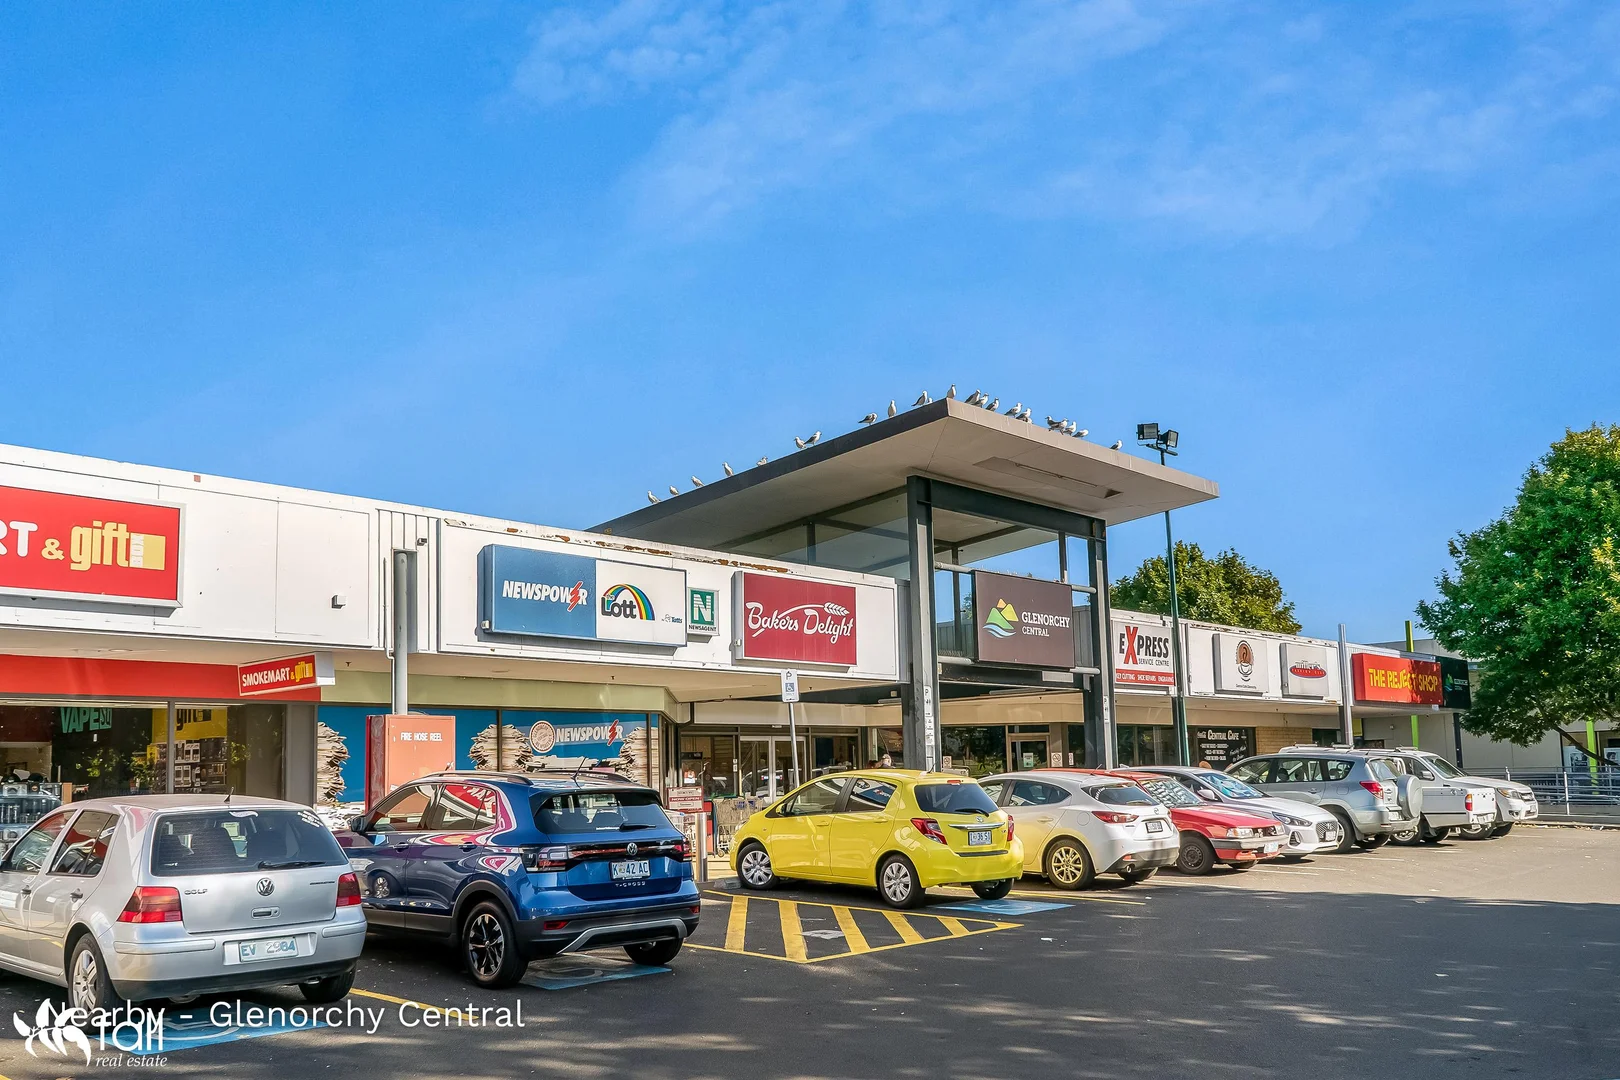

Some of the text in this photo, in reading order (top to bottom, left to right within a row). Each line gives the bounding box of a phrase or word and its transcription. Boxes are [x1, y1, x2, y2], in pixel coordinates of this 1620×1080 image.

[0, 519, 130, 571] T & gift
[502, 580, 588, 612] NEWSPOWER
[601, 597, 637, 619] Lott
[745, 602, 854, 644] Bakers Delight
[1021, 611, 1070, 628] GLENORCHY
[1021, 626, 1050, 637] CENTRAL
[1119, 625, 1169, 665] EXPRESS
[1138, 658, 1170, 667] SERVICE CENTRE
[242, 667, 290, 687] SMOKEMART
[1368, 668, 1438, 692] THE REJECT SHOP
[60, 707, 99, 733] VAPE
[400, 732, 443, 742] FIRE HOSE REEL
[556, 719, 623, 746] NEWSPOWER
